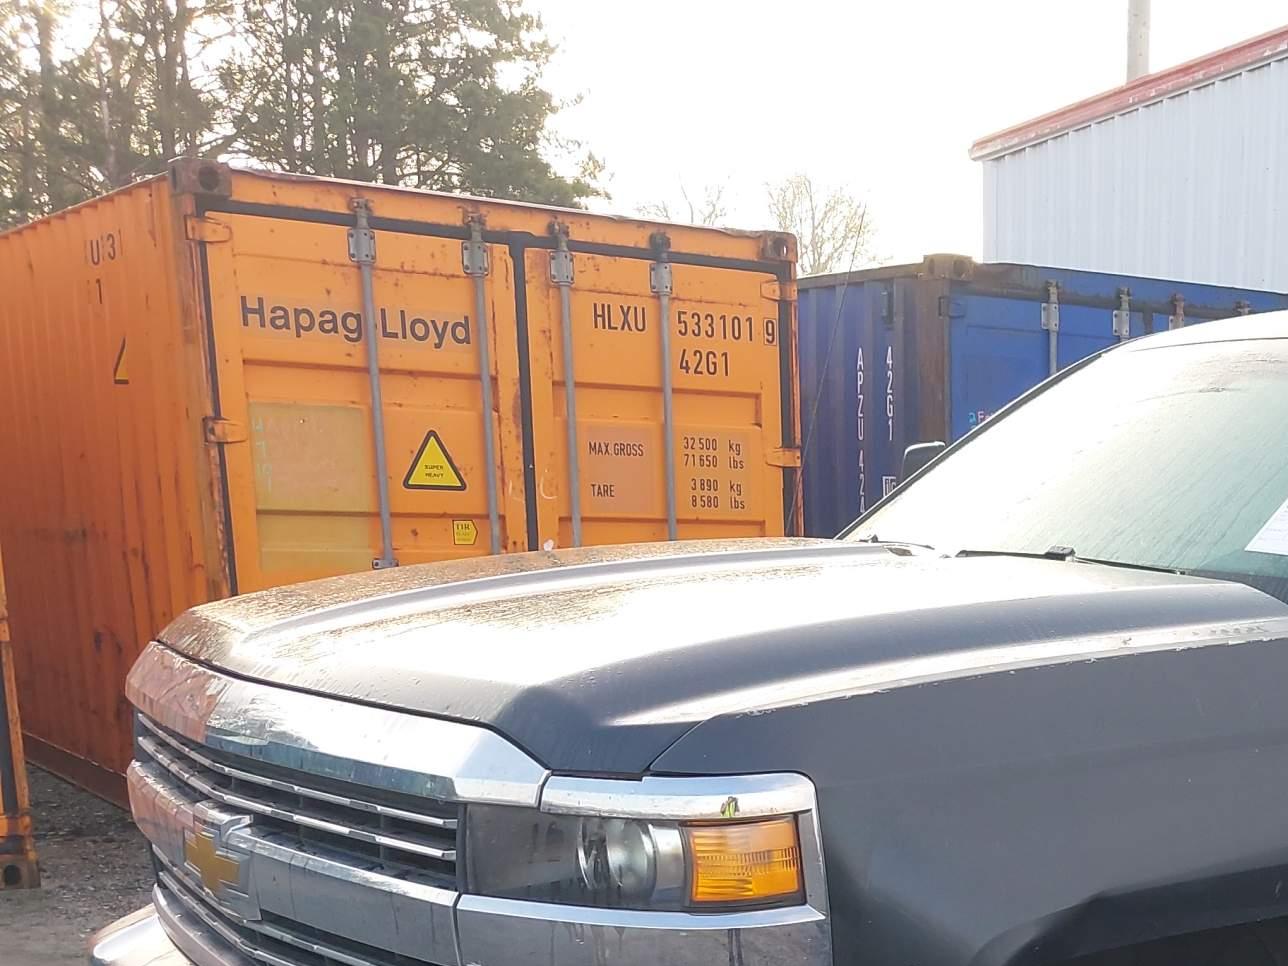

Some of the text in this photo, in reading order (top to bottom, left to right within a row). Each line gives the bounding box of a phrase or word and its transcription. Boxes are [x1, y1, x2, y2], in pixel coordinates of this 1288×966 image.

[593, 302, 776, 345] HLXU 533101 9
[679, 348, 729, 377] 42G1
[886, 345, 894, 441] 42G1
[729, 440, 741, 455] kg
[729, 456, 744, 470] lbs
[591, 483, 615, 498] TARE
[729, 480, 742, 496] kg
[730, 497, 745, 510] lbs
